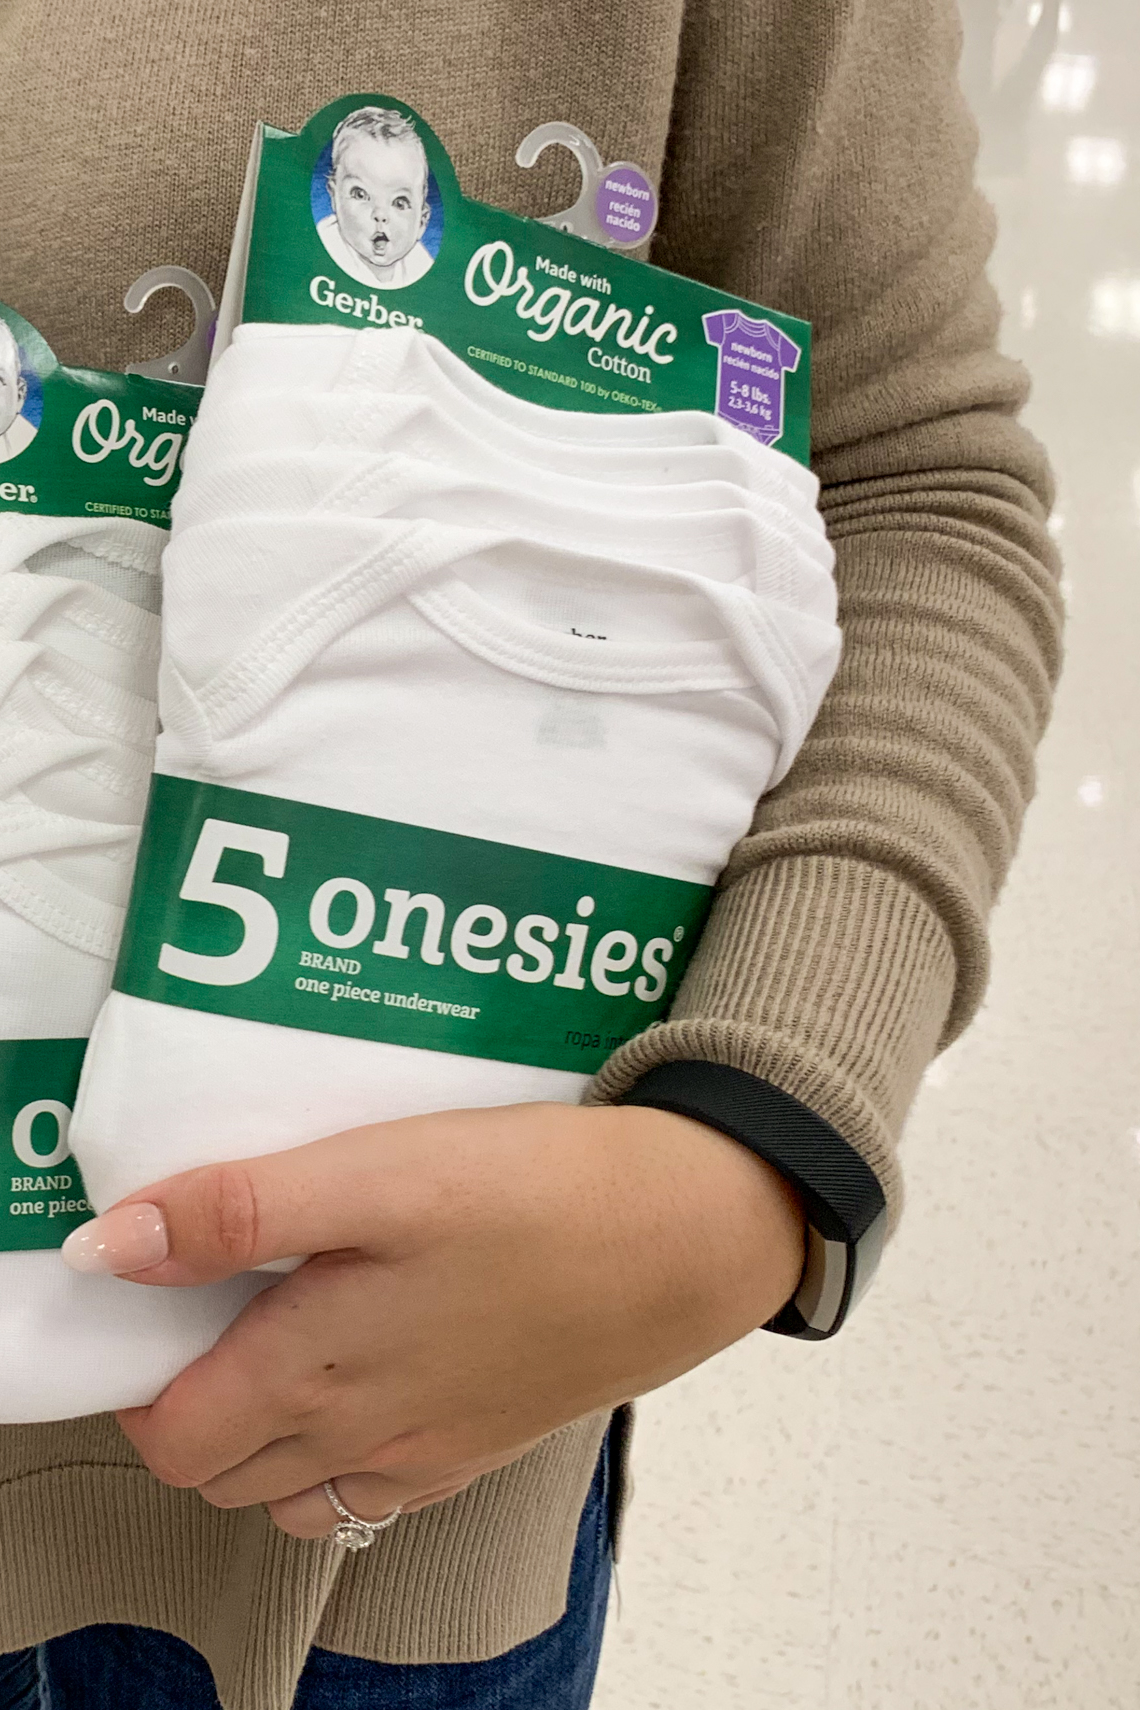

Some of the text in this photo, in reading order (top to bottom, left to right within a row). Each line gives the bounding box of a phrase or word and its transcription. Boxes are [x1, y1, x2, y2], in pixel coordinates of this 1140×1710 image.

[604, 180, 650, 201] newborn
[608, 201, 641, 218] recién
[606, 214, 641, 232] nacido
[535, 255, 612, 295] Made with
[464, 241, 678, 364] Organic
[730, 342, 773, 364] newborn
[466, 346, 512, 369] CERTIFIED
[513, 359, 527, 373] TO
[527, 364, 578, 388] STANDARD
[580, 380, 597, 394] 100
[597, 385, 610, 400] by
[586, 347, 652, 384] Cotton
[750, 364, 779, 380] nacido
[729, 380, 771, 405] 5-8 lbs.
[142, 406, 187, 426] Made
[759, 404, 772, 421] kg
[72, 398, 184, 487] Org
[85, 502, 133, 516] CERTIFIED
[134, 507, 148, 518] TO
[158, 818, 290, 987] 5
[299, 951, 362, 975] BRAND
[294, 976, 481, 1020] one piece underwear
[564, 1030, 601, 1051] ropa
[10, 1175, 73, 1192] BRAND
[9, 1200, 45, 1216] one
